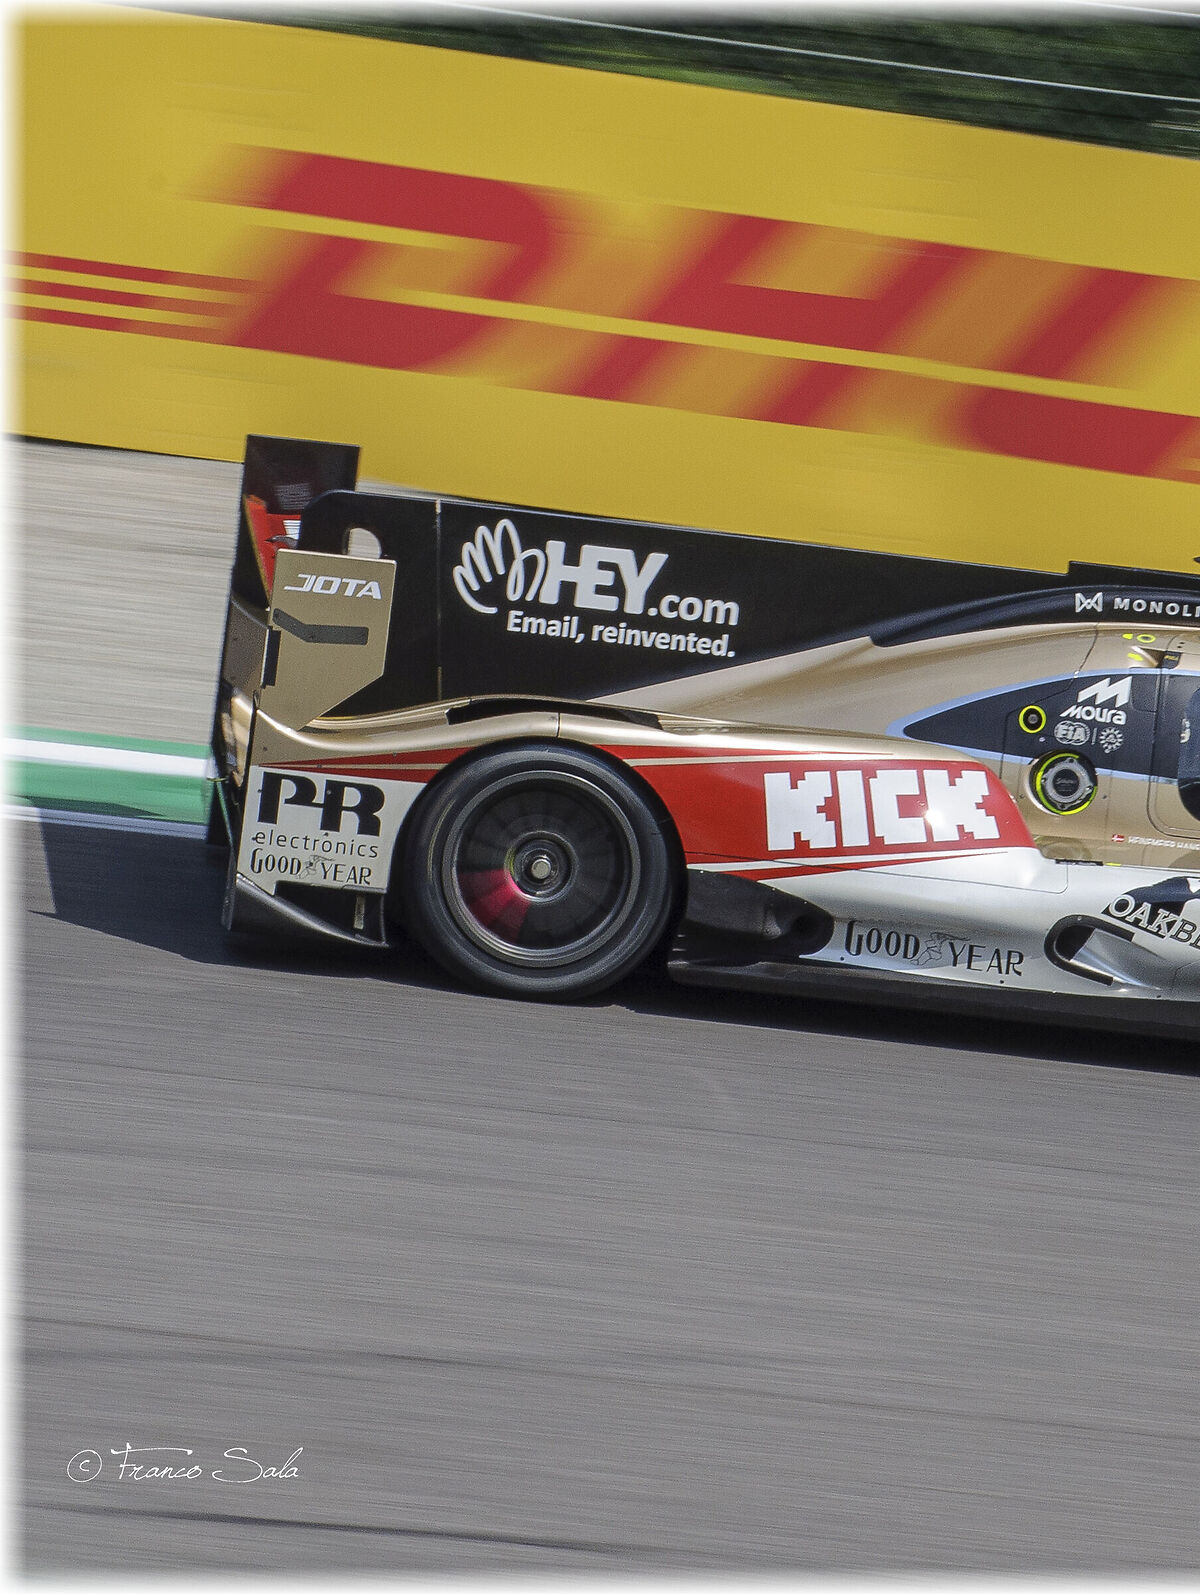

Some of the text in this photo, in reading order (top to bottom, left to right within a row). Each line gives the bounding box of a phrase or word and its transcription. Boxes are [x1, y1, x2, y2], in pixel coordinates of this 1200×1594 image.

[284, 573, 382, 601] JOTA
[539, 540, 740, 626] HEY.com
[507, 610, 736, 658] Email, reinvented.
[257, 771, 386, 837] PR
[763, 769, 1001, 852] KICK
[250, 848, 372, 885] GOOD YEAR
[255, 829, 379, 858] electronics
[844, 919, 1025, 977] GOOD YEAR
